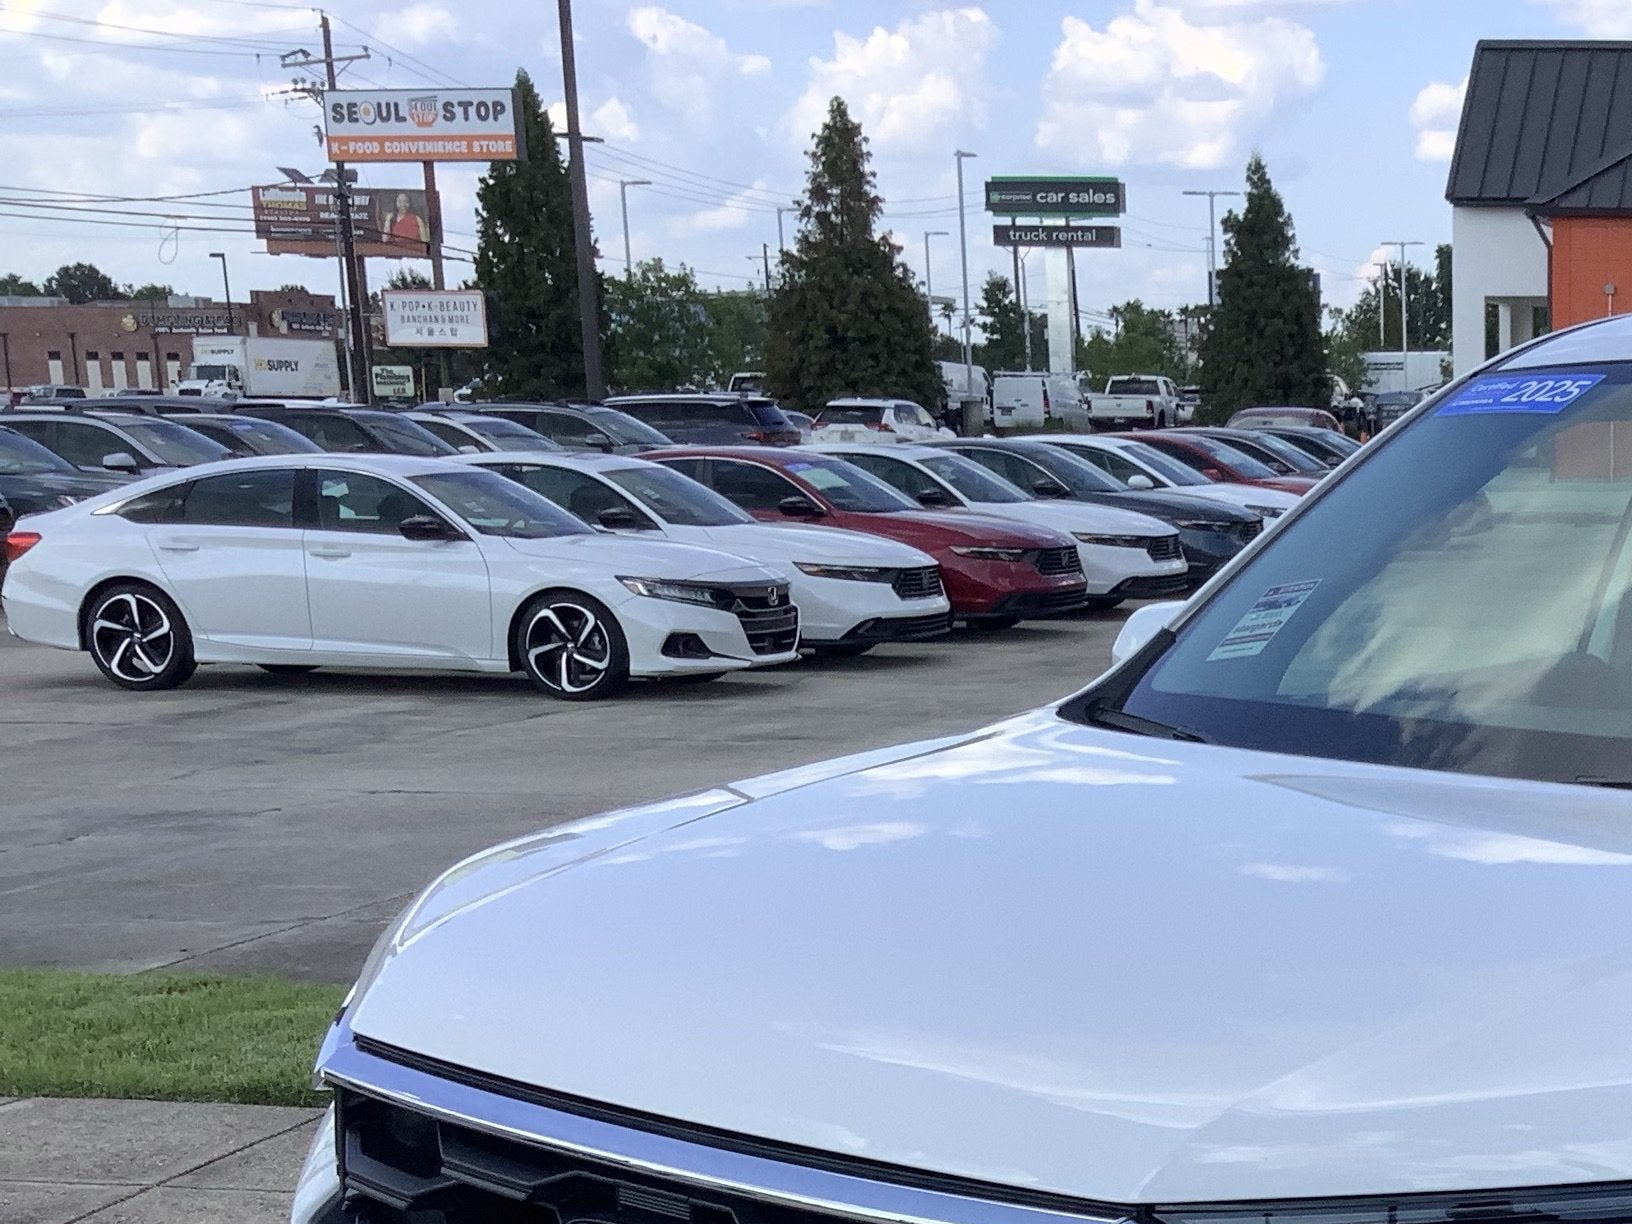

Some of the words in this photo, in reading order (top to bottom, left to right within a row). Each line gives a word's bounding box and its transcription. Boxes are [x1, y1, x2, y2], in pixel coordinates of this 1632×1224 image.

[332, 101, 407, 125] SEOUL
[442, 101, 507, 122] STOP
[384, 141, 468, 153] CONVENIENCE
[472, 140, 512, 152] STORE
[1036, 192, 1065, 203] car
[1069, 189, 1115, 204] sales
[1009, 228, 1047, 241] truck
[1053, 229, 1096, 241] rental
[268, 360, 299, 372] SUPPLY
[1500, 380, 1593, 402] 2025
